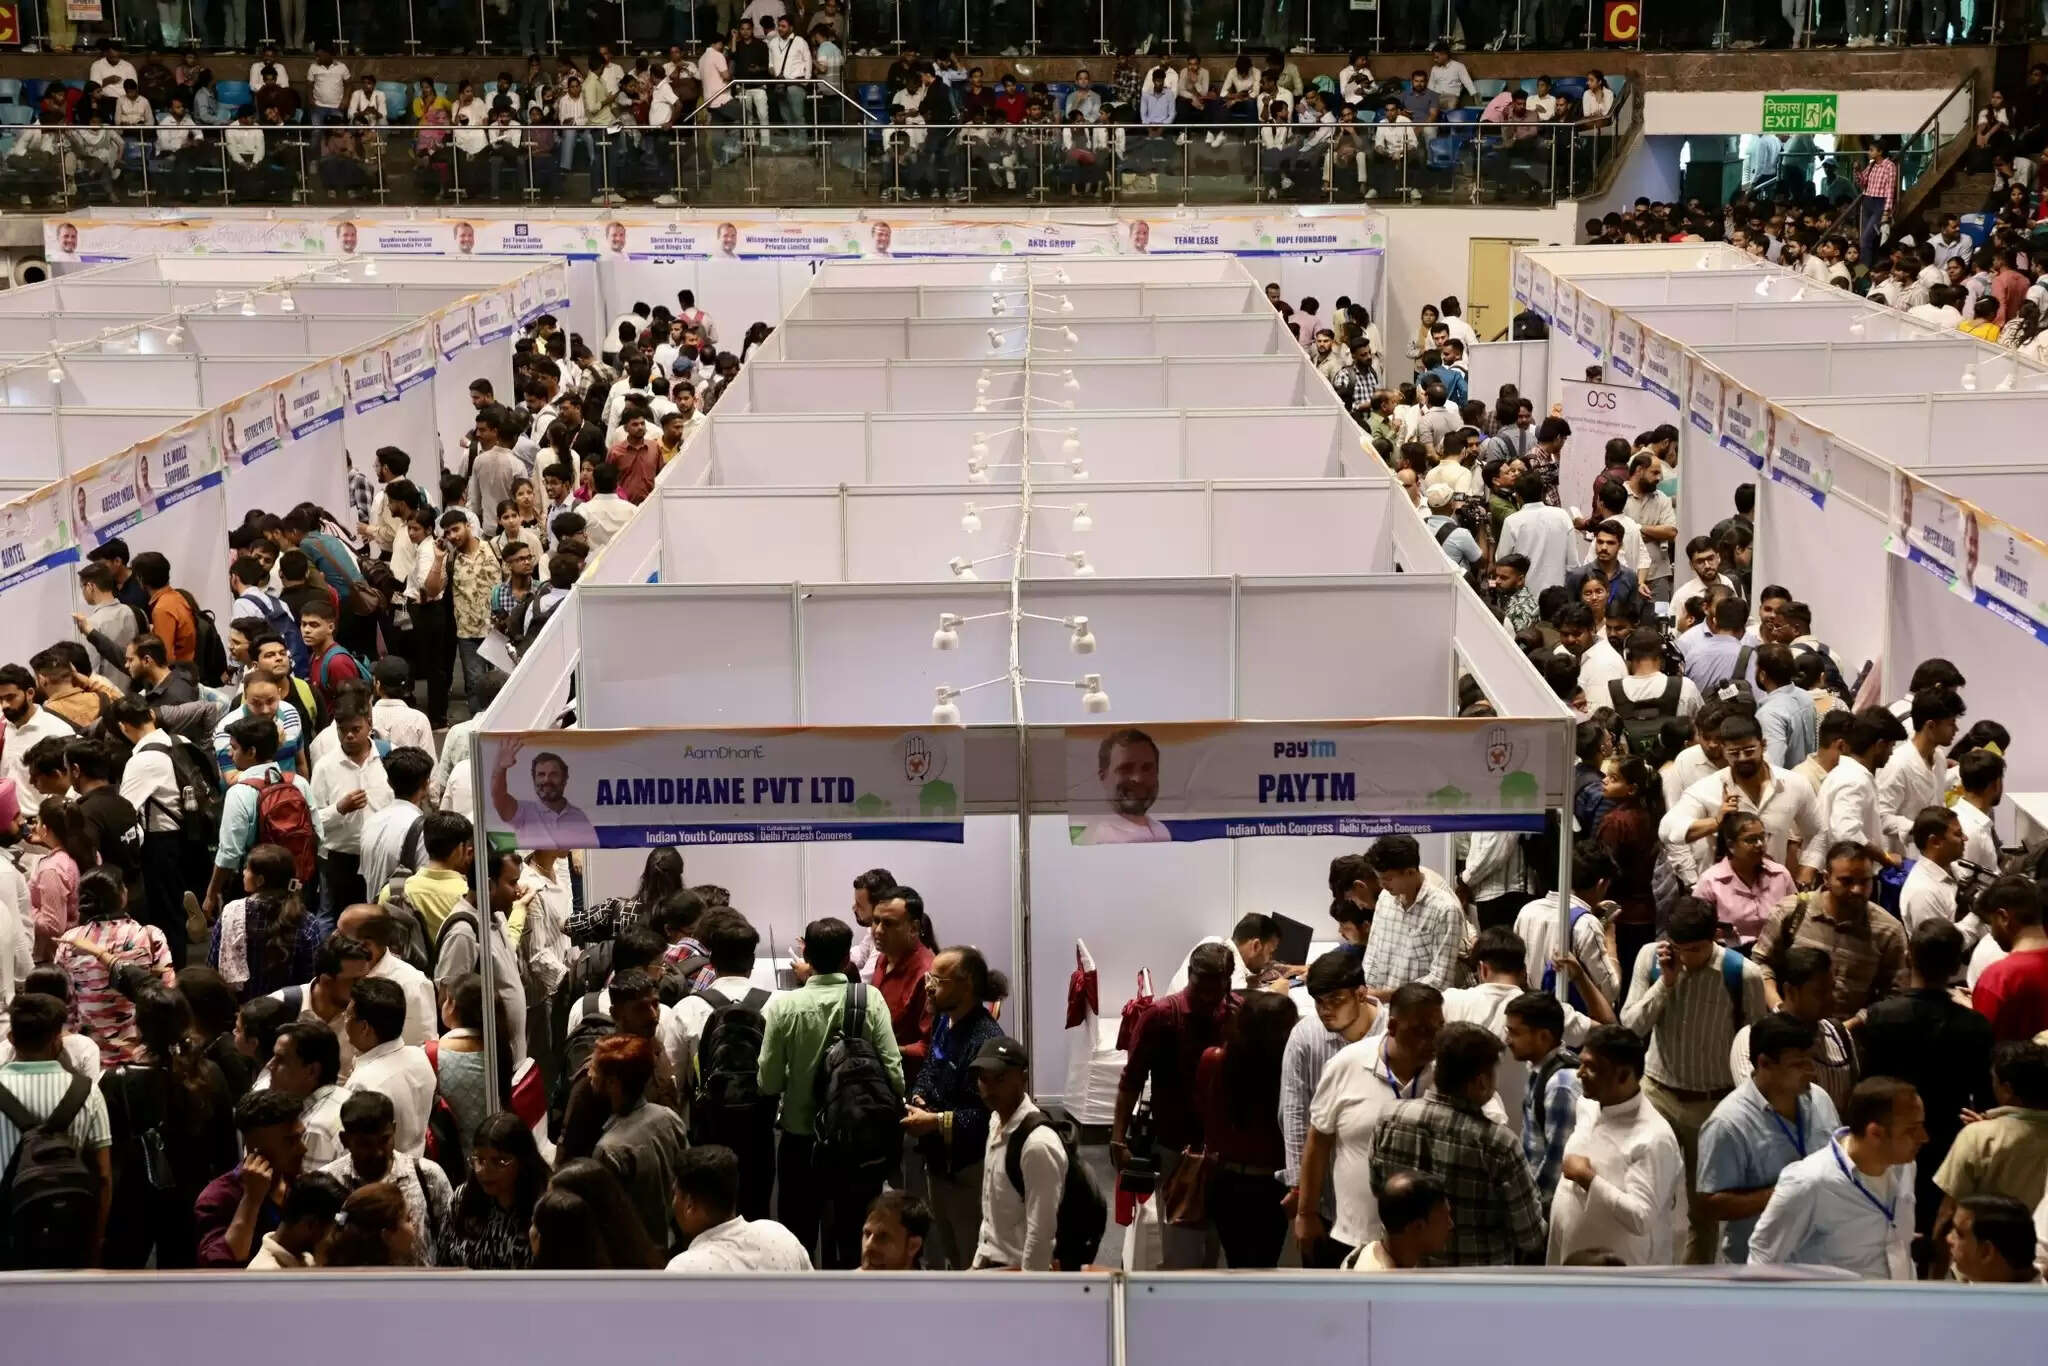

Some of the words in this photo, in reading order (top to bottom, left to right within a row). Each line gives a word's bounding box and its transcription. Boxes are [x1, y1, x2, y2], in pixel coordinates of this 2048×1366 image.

[1609, 3, 1637, 39] C
[1765, 98, 1801, 114] निकास
[1764, 115, 1800, 128] EXIT
[1049, 239, 1076, 249] GROUP
[1174, 236, 1196, 245] TEAM
[1196, 236, 1219, 245] LEASE
[1276, 236, 1294, 244] HOPE
[1295, 235, 1337, 244] FOUNDATION
[1587, 390, 1617, 410] OCS
[1, 542, 26, 570] AIRTEL
[1274, 739, 1336, 759] paytm
[596, 777, 745, 806] AAMDHANE
[753, 777, 803, 804] PVT
[810, 776, 855, 804] LTD
[1258, 772, 1355, 804] PAYTM
[760, 831, 781, 841] Delhi
[781, 830, 815, 841] Pradesh
[815, 830, 853, 841] Congress
[1226, 824, 1256, 836] Indian
[1258, 823, 1287, 835] Youth
[1288, 822, 1334, 836] Congress
[1339, 823, 1360, 833] Delhi
[1361, 823, 1393, 834] Pradesh
[1394, 823, 1432, 833] Congress
[646, 831, 677, 844] Indian
[678, 830, 707, 843] Youth
[709, 829, 755, 844] Congress
